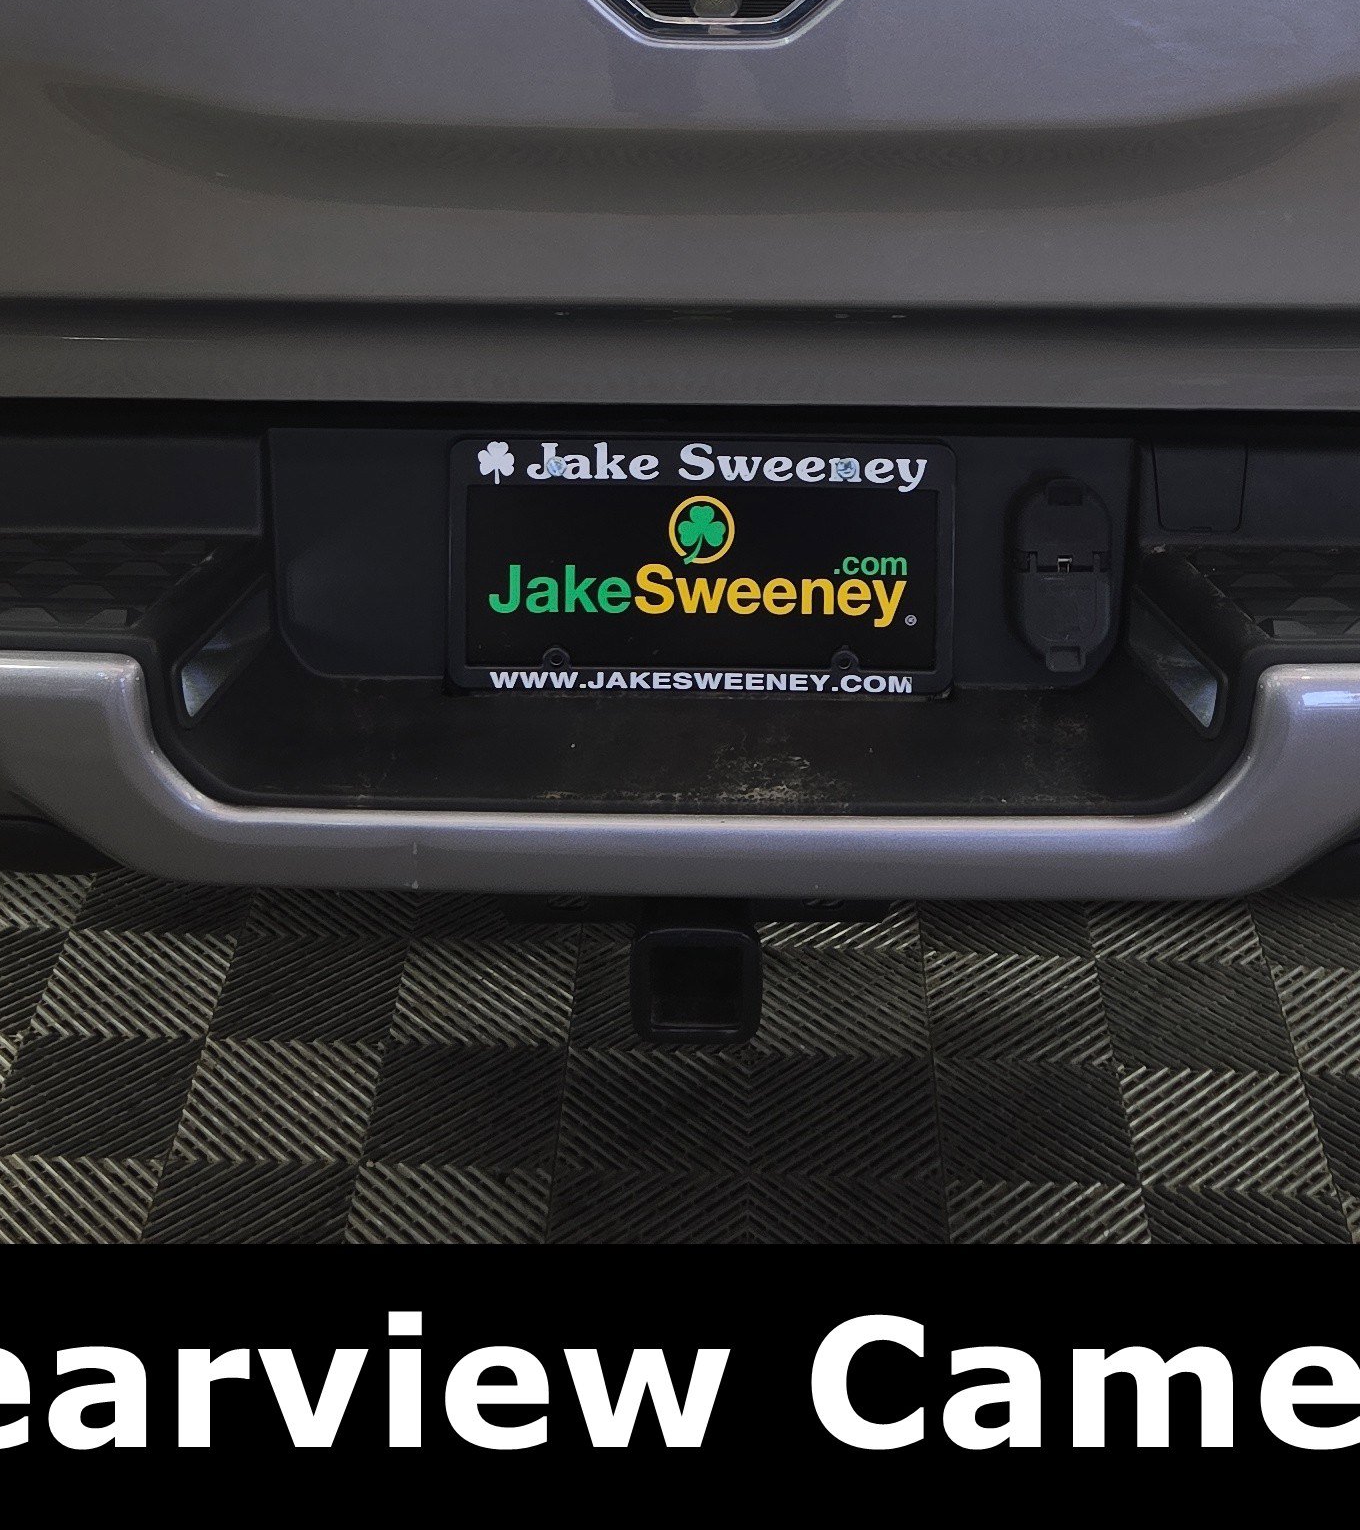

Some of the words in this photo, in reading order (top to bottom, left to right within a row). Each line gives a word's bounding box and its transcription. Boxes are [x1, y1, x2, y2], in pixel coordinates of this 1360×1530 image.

[527, 442, 659, 480] Jake
[678, 443, 928, 492] Sweeney
[489, 671, 913, 694] WWW.JAKESWEENEY.COM
